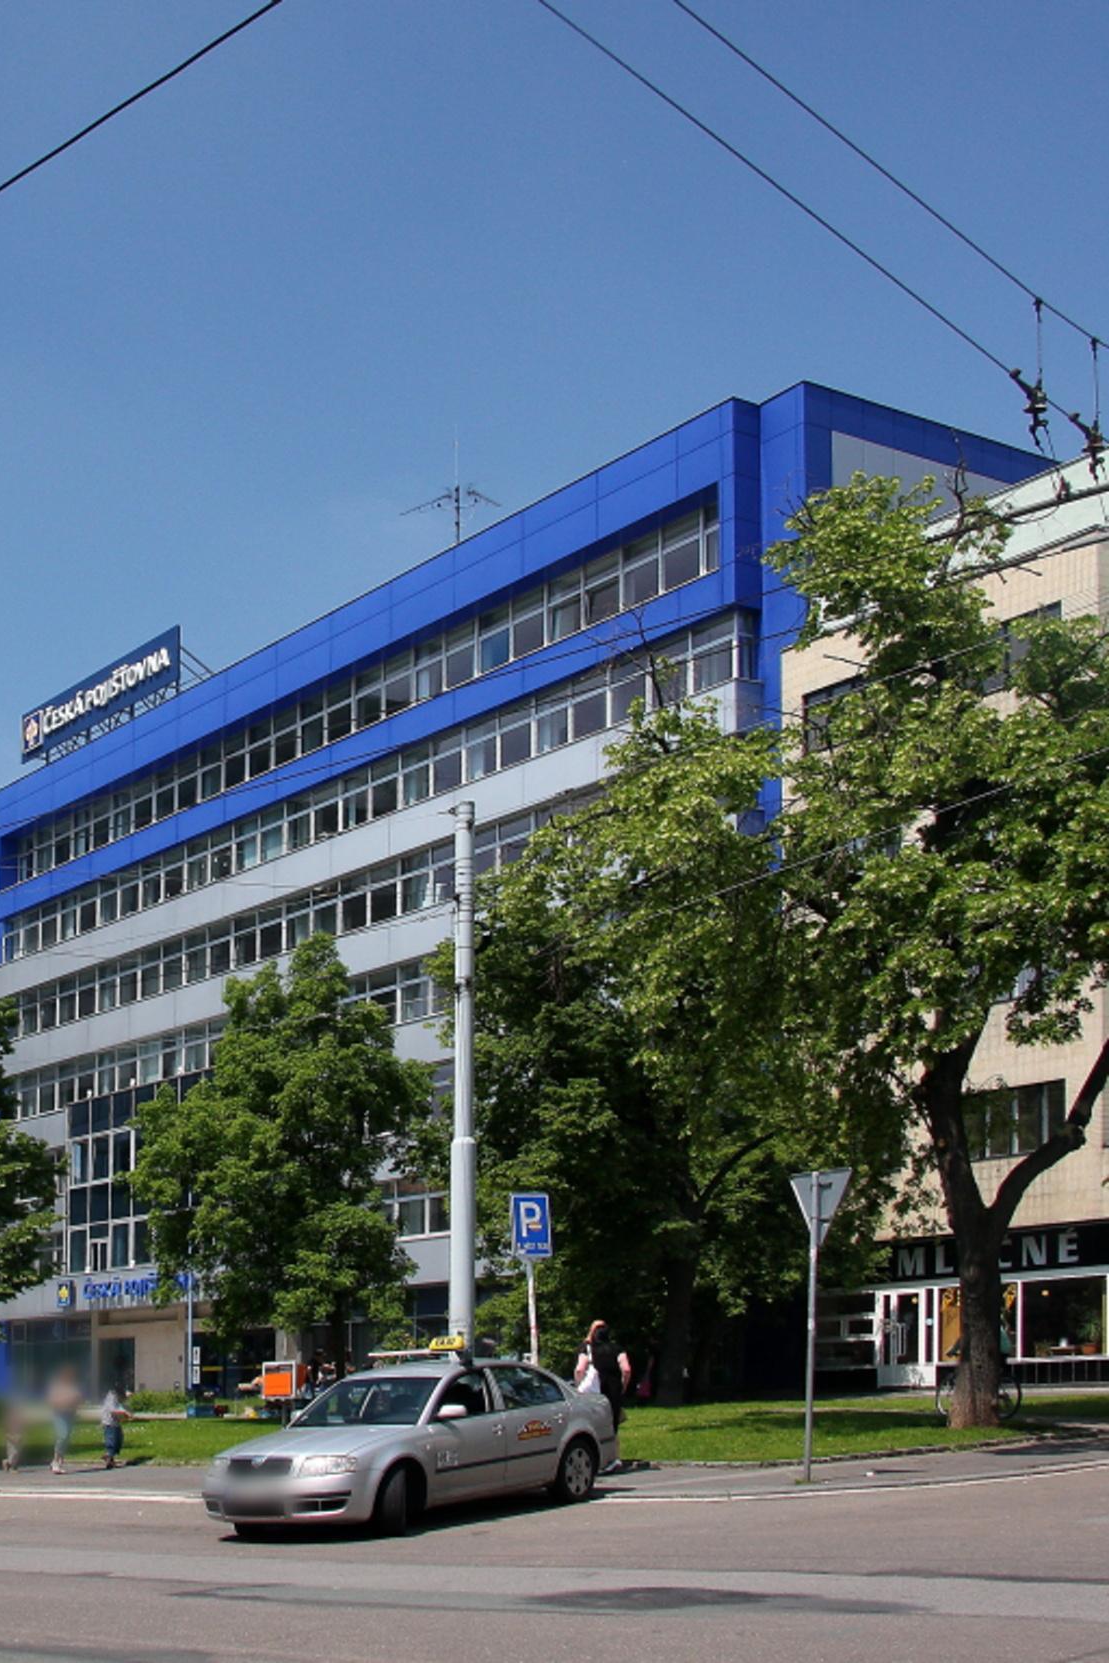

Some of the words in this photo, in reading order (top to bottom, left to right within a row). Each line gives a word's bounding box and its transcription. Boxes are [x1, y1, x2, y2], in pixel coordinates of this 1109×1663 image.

[42, 690, 86, 735] ČESKÁ
[85, 647, 171, 711] POJIŠŤOVNA
[519, 1201, 541, 1238] P
